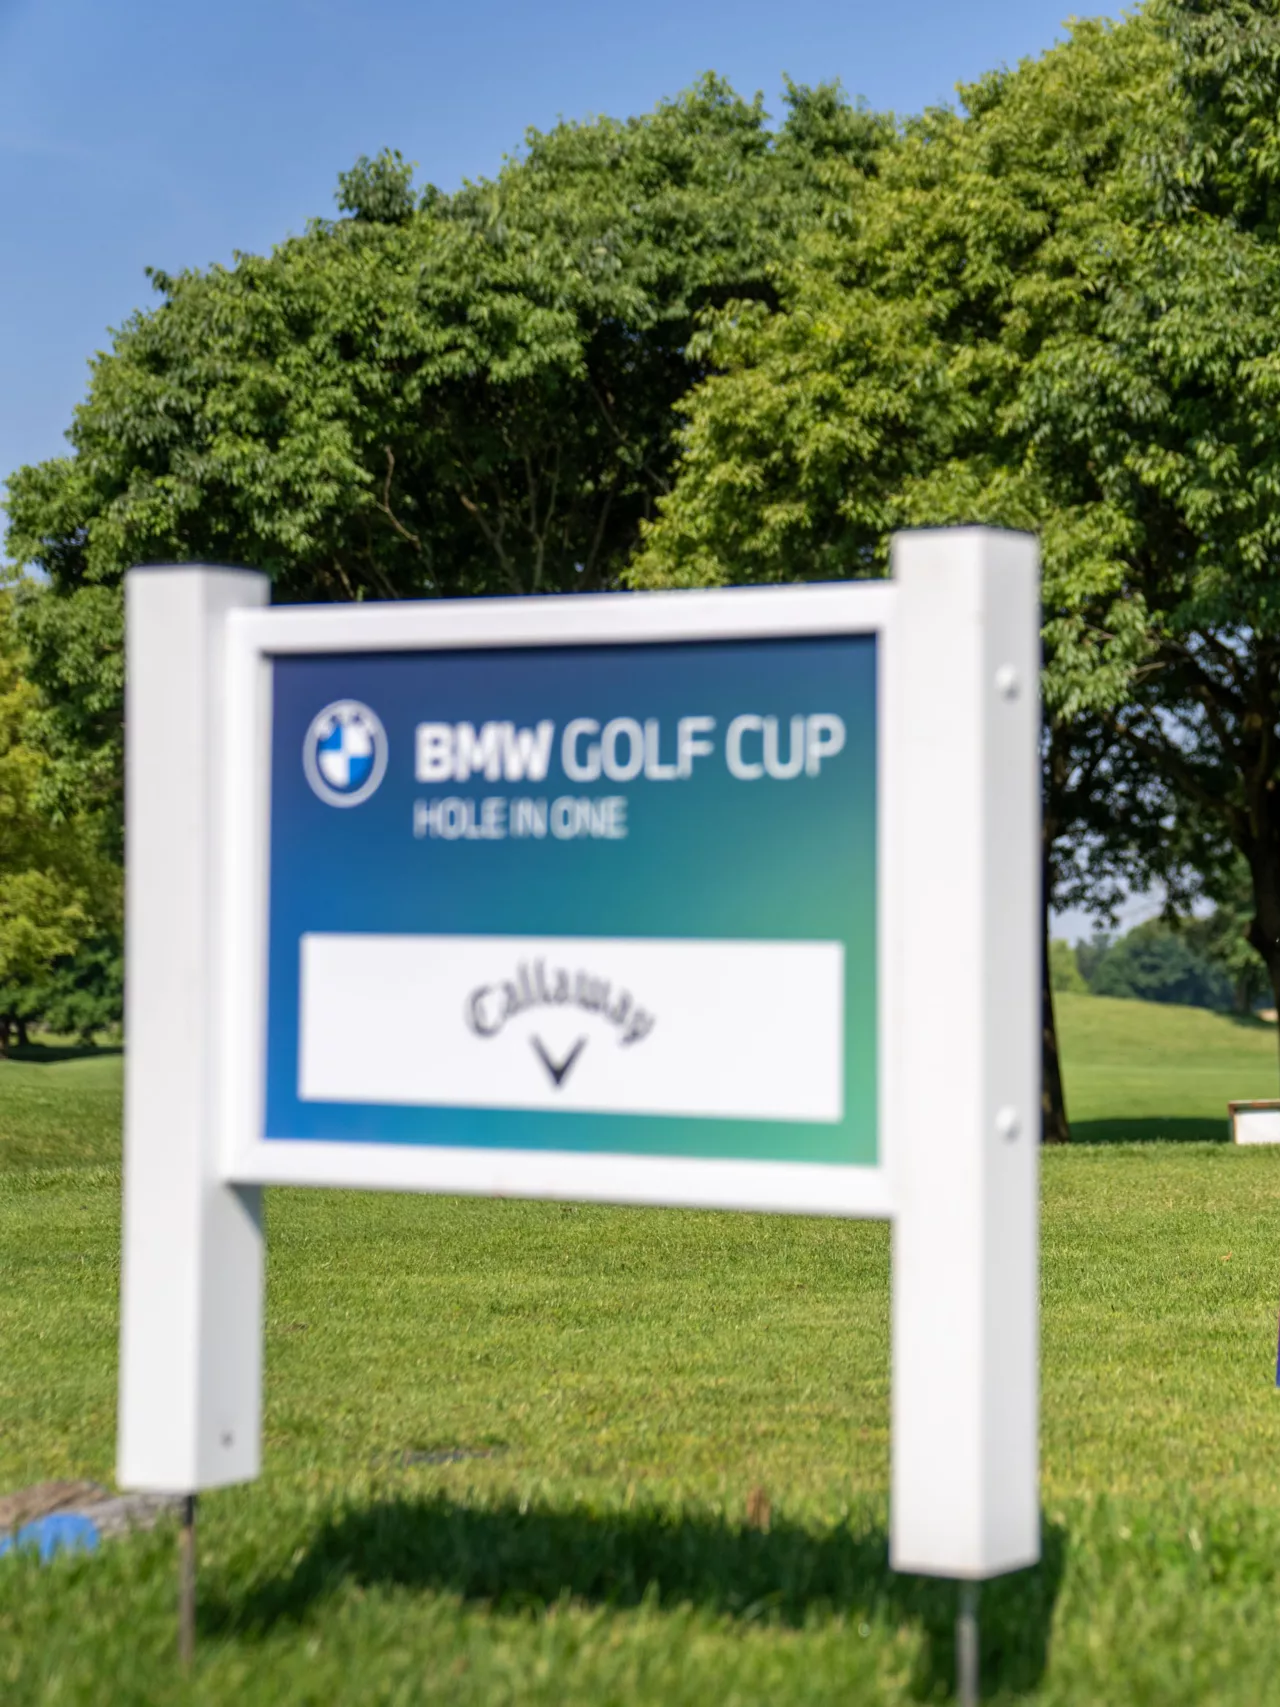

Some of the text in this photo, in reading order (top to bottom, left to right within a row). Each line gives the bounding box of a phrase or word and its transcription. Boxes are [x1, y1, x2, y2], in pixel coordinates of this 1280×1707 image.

[415, 719, 555, 782] BMW
[561, 716, 716, 782] GOLF
[725, 713, 846, 780] CUP
[413, 795, 628, 839] HOLE IN ONE
[465, 956, 654, 1048] Callaway
